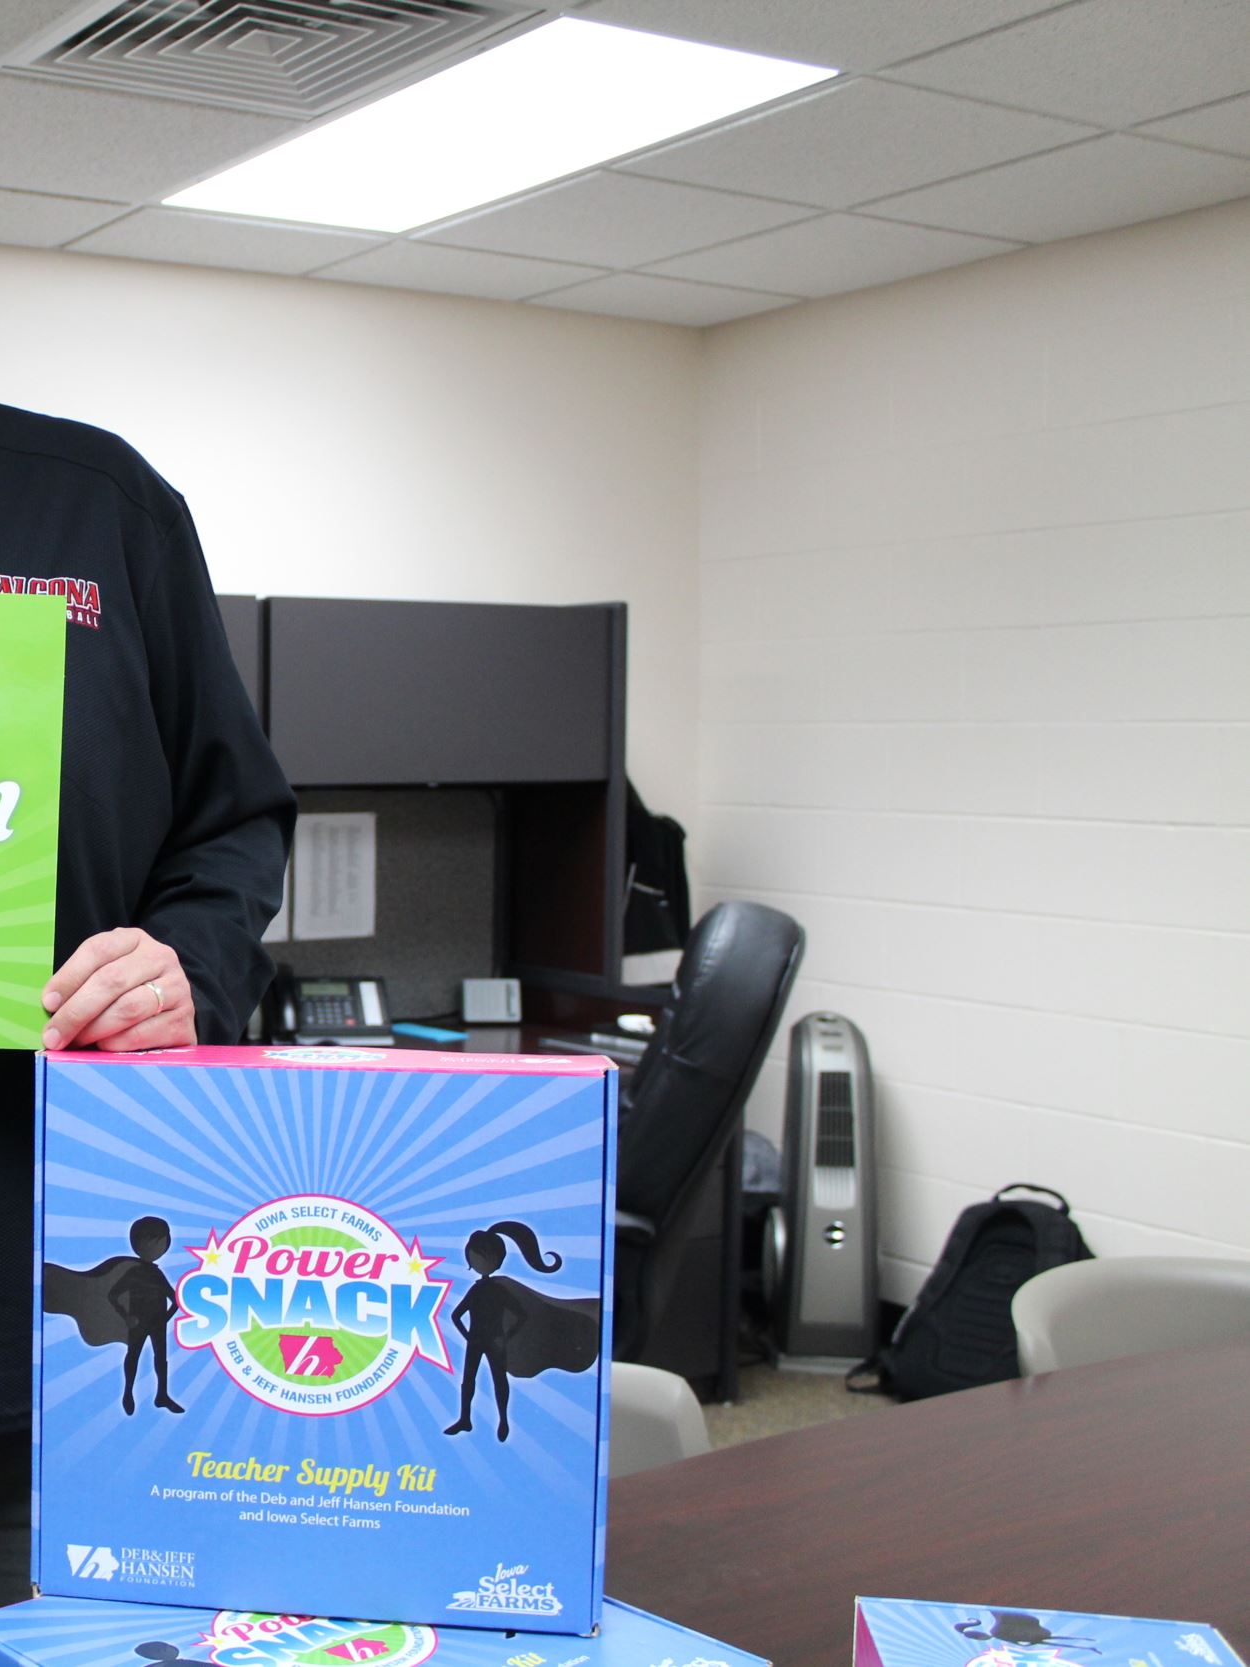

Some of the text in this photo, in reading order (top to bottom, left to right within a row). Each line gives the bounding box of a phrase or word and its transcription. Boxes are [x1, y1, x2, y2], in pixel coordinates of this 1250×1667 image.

[255, 1206, 383, 1242] IOWA SELECT FARMS
[227, 1236, 400, 1280] Power
[179, 1274, 448, 1365] SNACK
[226, 1340, 399, 1404] DEB & JEFF HANSEN FOUNDATION
[186, 1451, 437, 1497] Teacher Supply Kit
[150, 1485, 470, 1517] A program of the Deb and Jeff Hansen Foundation
[238, 1509, 381, 1529] and Iowa Select Farms
[120, 1576, 196, 1588] FOUNDATION
[121, 1561, 195, 1580] HANSEN
[495, 1562, 530, 1582] Iowa
[478, 1576, 555, 1598] Select
[478, 1594, 555, 1611] FARMS
